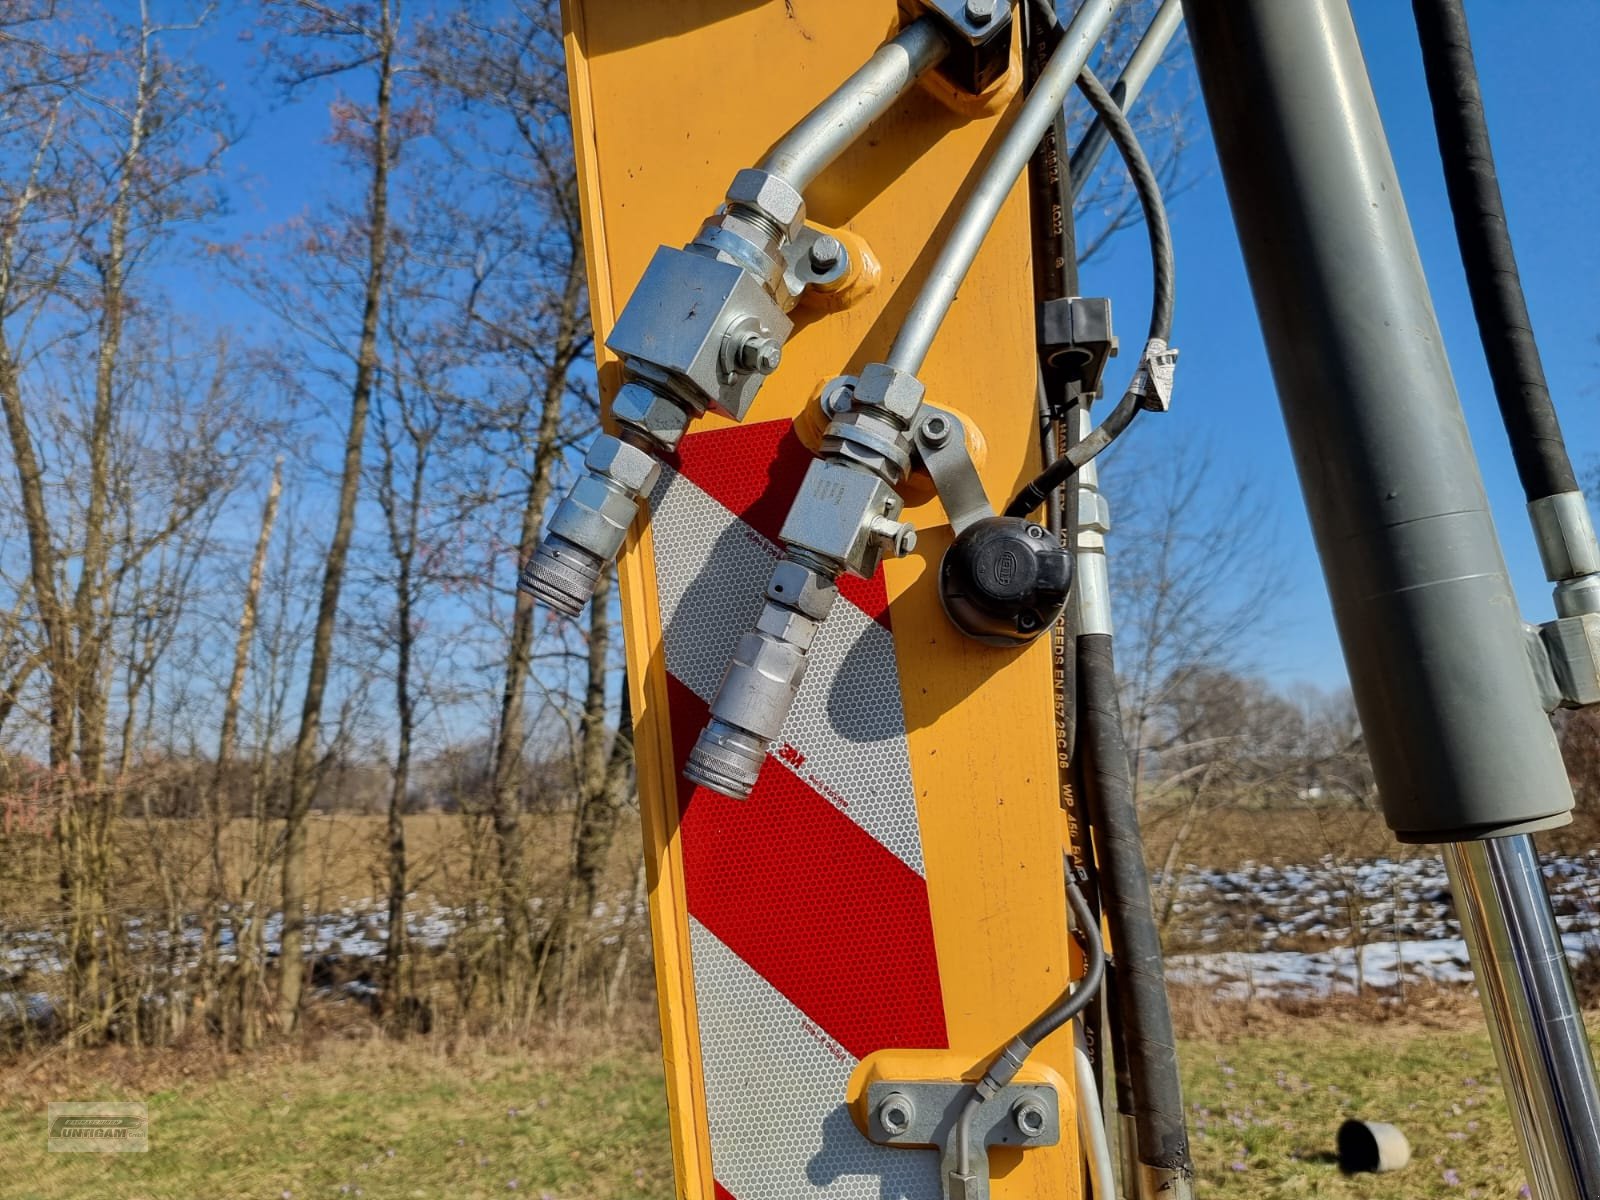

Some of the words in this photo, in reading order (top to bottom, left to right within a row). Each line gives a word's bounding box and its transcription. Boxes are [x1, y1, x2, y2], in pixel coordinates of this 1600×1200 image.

[1055, 613, 1066, 665] CEEDS
[1054, 669, 1065, 689] EN
[1054, 693, 1066, 718] 857
[1055, 720, 1068, 749] 2SC
[778, 742, 806, 769] 3M
[1058, 752, 1070, 769] 06
[1063, 783, 1075, 807] WP
